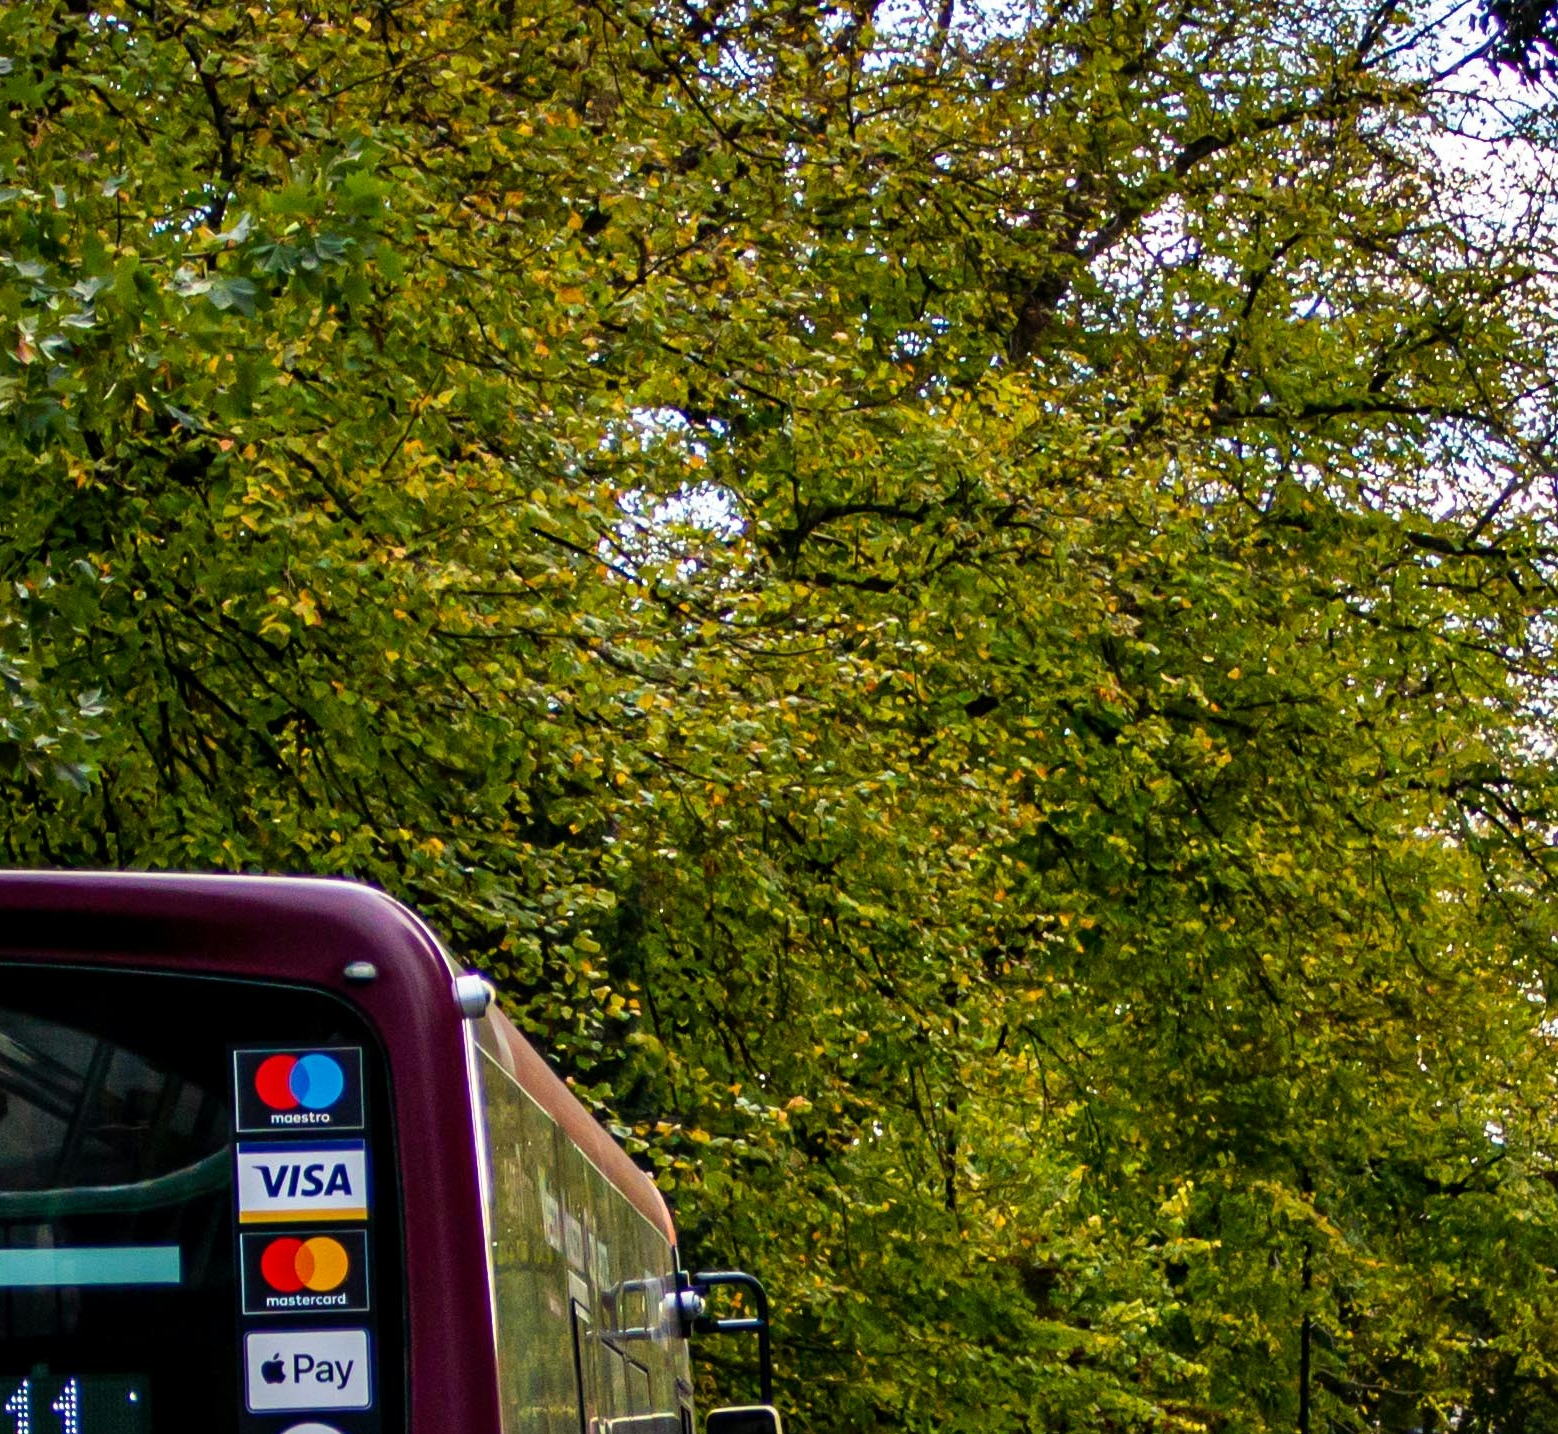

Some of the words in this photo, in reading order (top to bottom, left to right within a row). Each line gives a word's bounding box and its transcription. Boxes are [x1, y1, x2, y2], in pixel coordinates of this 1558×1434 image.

[270, 1110, 331, 1125] maestro
[251, 1162, 354, 1199] VISA
[265, 1291, 347, 1308] mastercard
[292, 1353, 355, 1392] Pay
